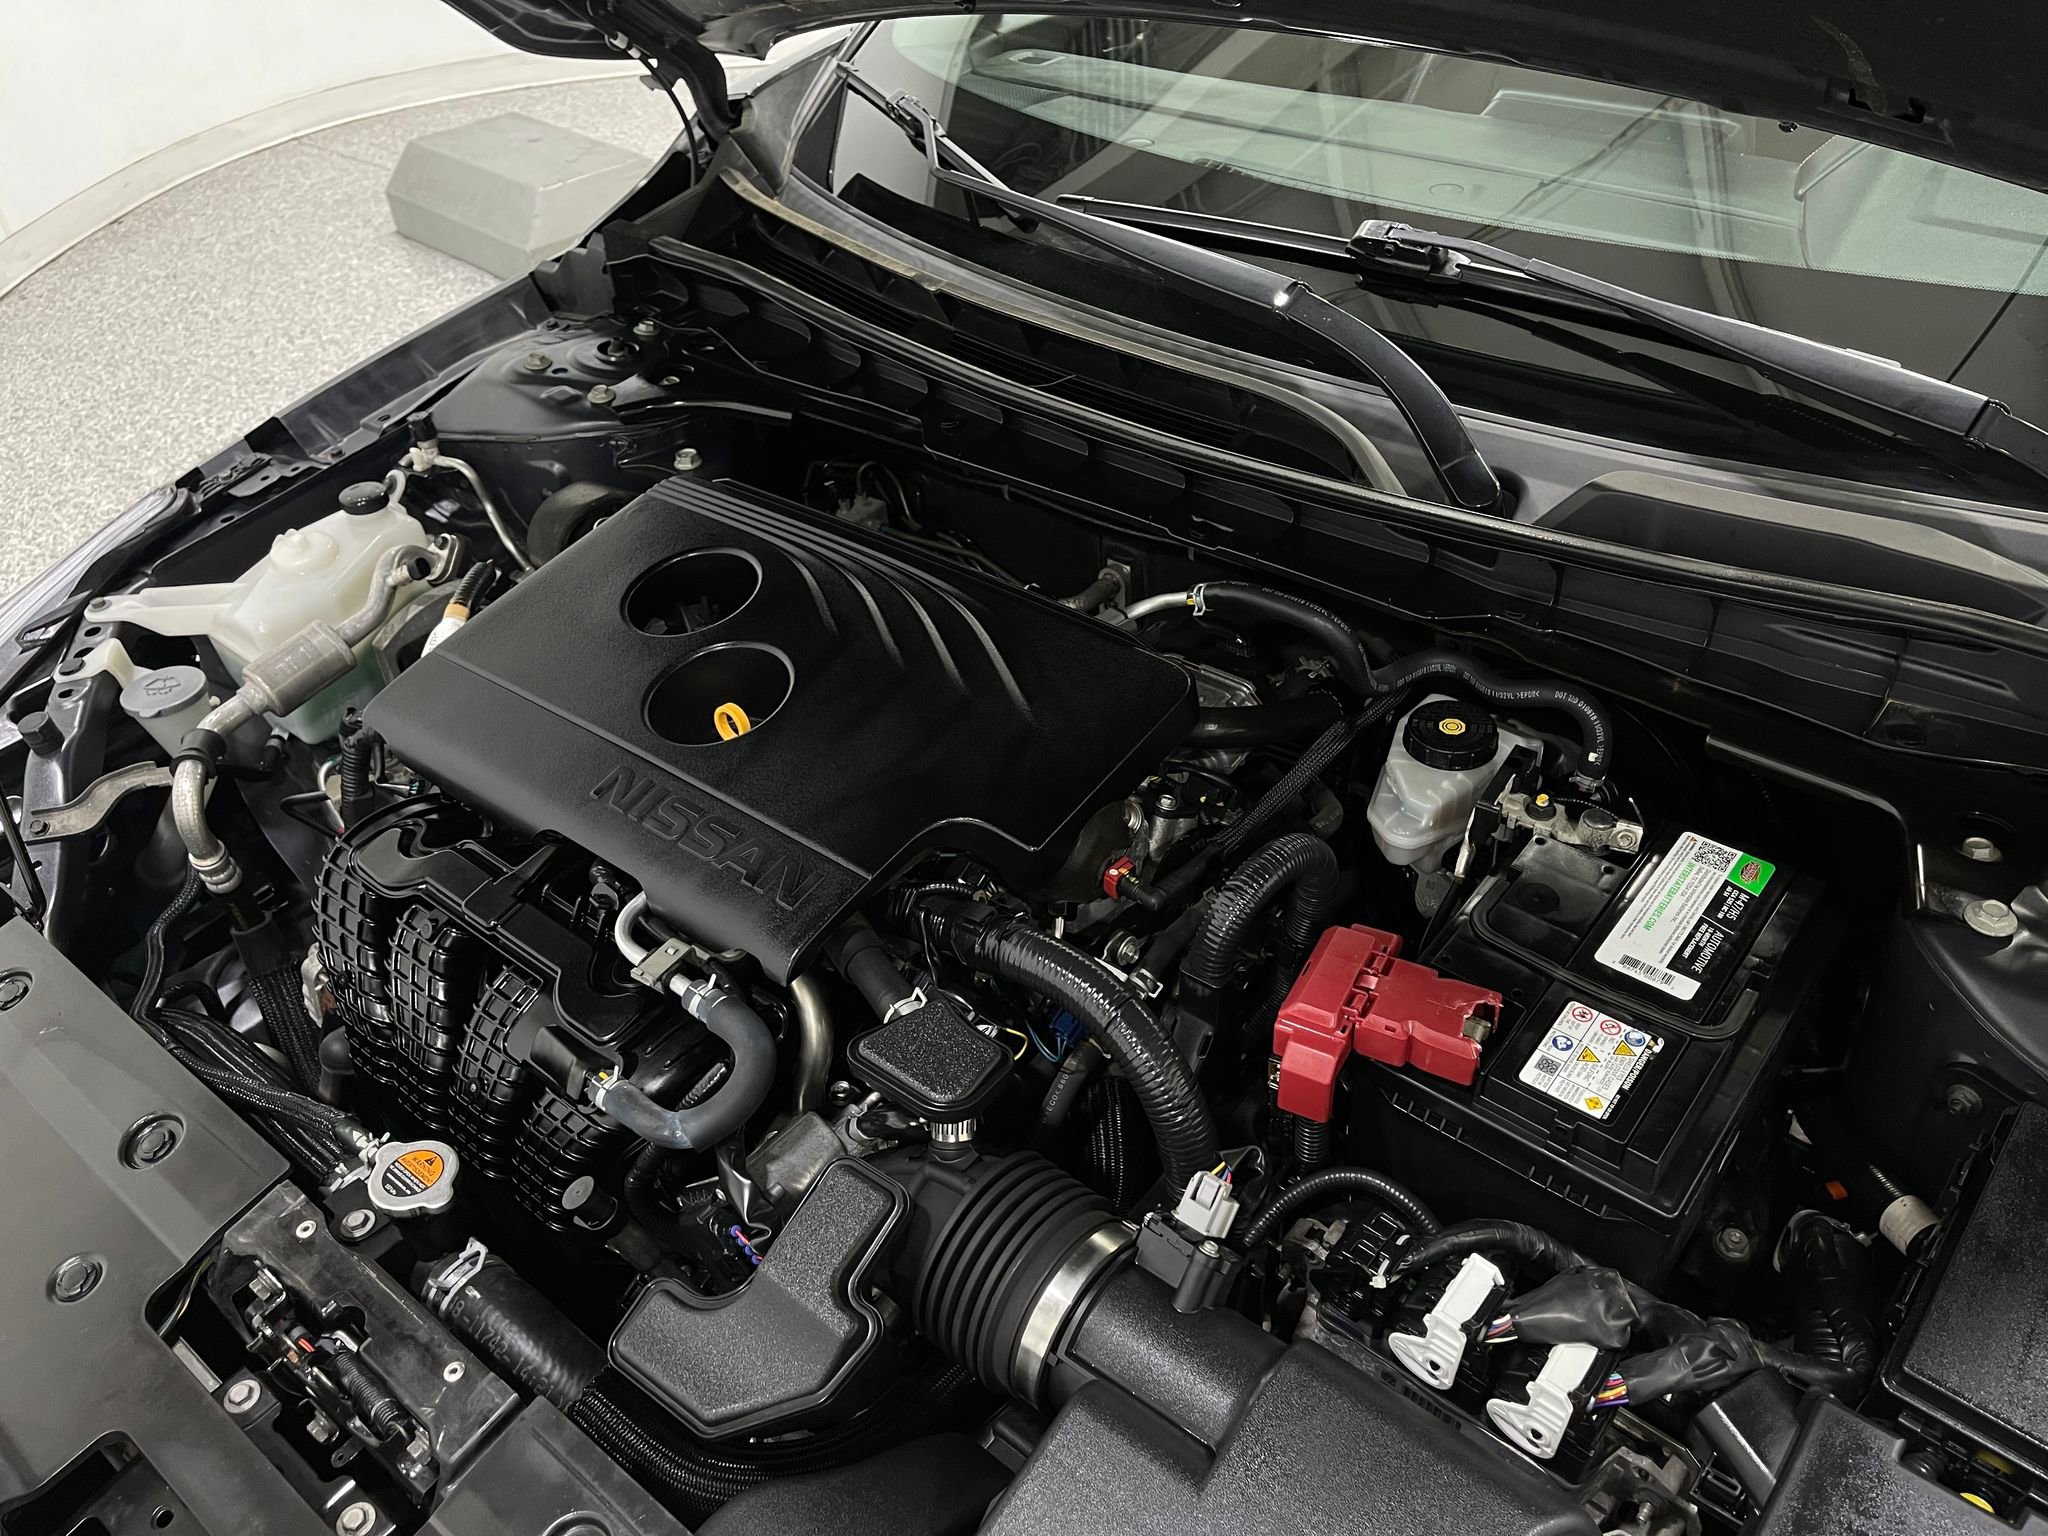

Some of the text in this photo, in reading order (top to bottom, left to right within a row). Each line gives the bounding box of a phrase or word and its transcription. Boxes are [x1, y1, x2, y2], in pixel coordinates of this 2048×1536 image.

[1554, 690, 1567, 700] DOT
[589, 764, 825, 911] NISSAN
[1643, 861, 1695, 931] INTERSTATEBATTERIES.COM
[1725, 892, 1749, 920] M-47/H5
[1681, 922, 1708, 958] FREE REPLACEMENT
[1690, 929, 1724, 974] AUTOMOTIVE
[1621, 1048, 1652, 1089] DANGER/POISON
[411, 1156, 436, 1177] WARNING
